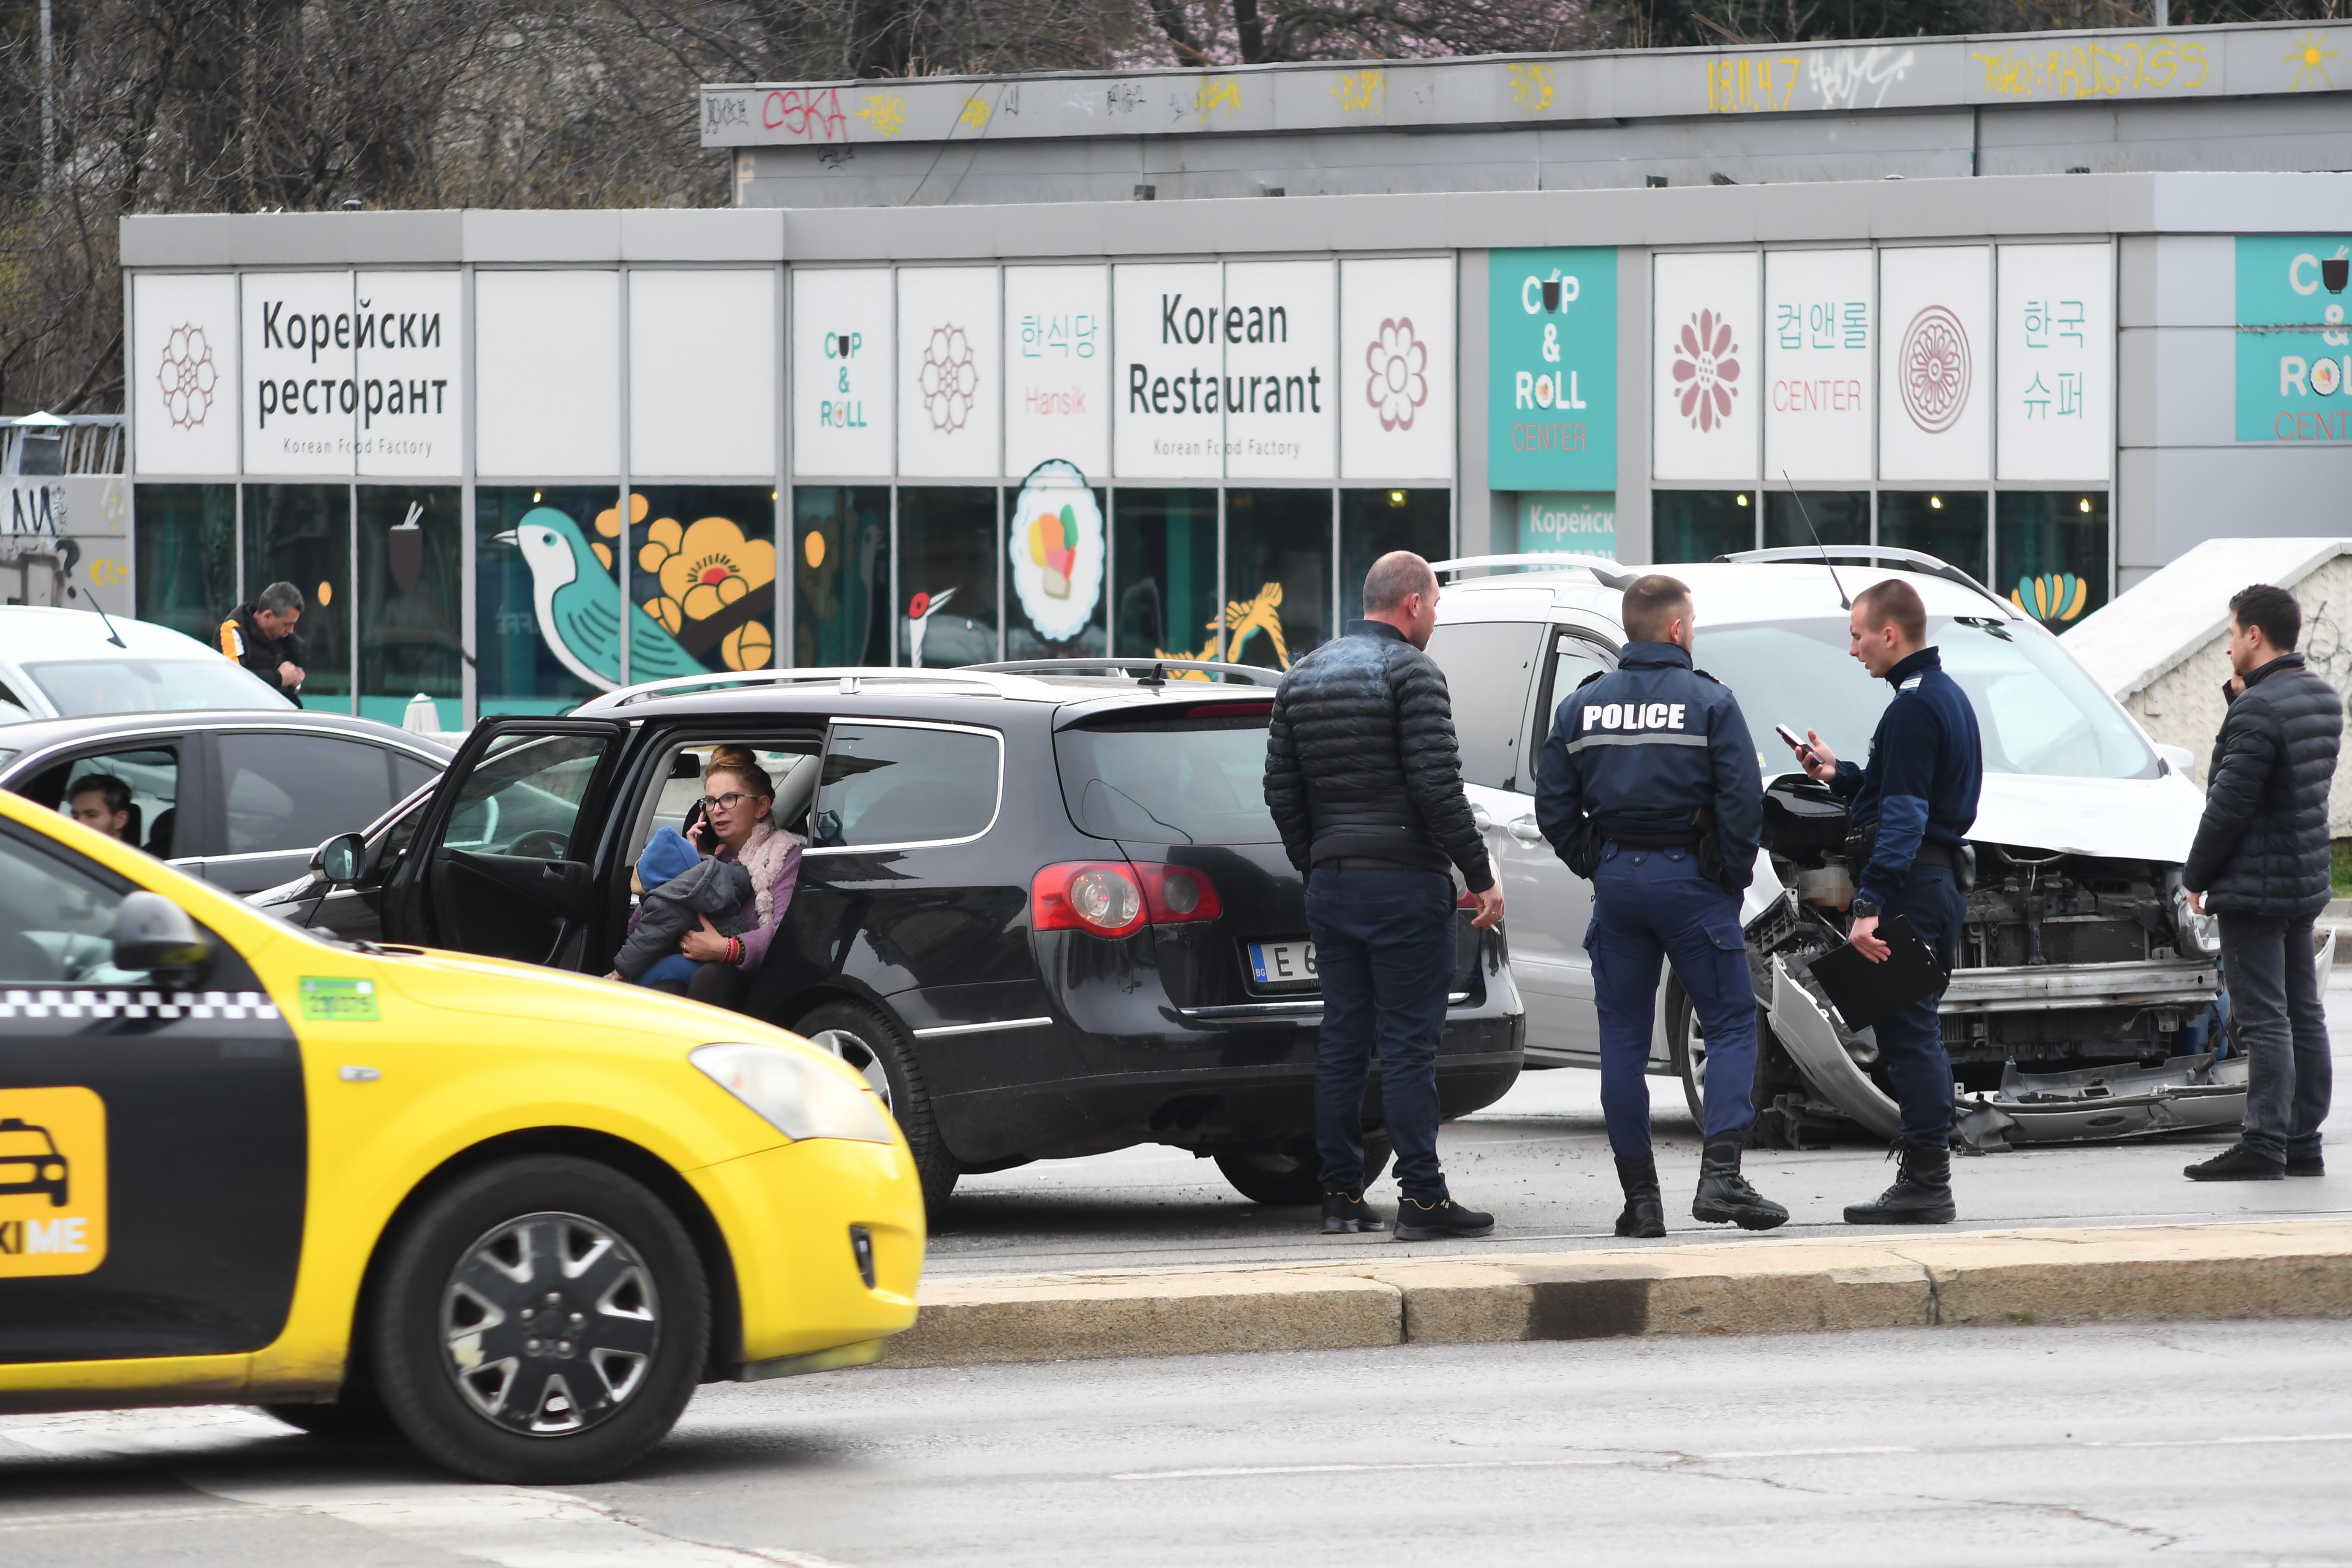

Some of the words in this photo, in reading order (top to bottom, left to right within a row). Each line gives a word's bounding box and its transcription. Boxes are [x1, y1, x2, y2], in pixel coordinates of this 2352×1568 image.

[763, 87, 847, 142] CSKA
[264, 298, 441, 363] Корейски
[1021, 315, 1097, 358] 한식당
[1162, 293, 1287, 345] Korean
[1777, 302, 1868, 349] 컵앤롤
[2024, 300, 2085, 348] 한국
[2323, 304, 2349, 346] &
[1542, 323, 1560, 362] &
[838, 365, 849, 393] &
[1129, 363, 1321, 414] Restaurant
[1516, 371, 1586, 410] ROLL
[1773, 380, 1861, 413] CENTER
[2023, 372, 2083, 420] 슈퍼
[259, 379, 448, 430] ресторант
[821, 400, 867, 428] ROLL
[1026, 387, 1086, 415] Hansik
[284, 438, 332, 454] Korean
[379, 438, 432, 458] Factory
[1154, 439, 1200, 455] Korean
[1249, 438, 1300, 459] Factory
[1511, 424, 1586, 451] CENTER
[1583, 703, 1685, 731] POLICE
[1255, 968, 1266, 977] BG
